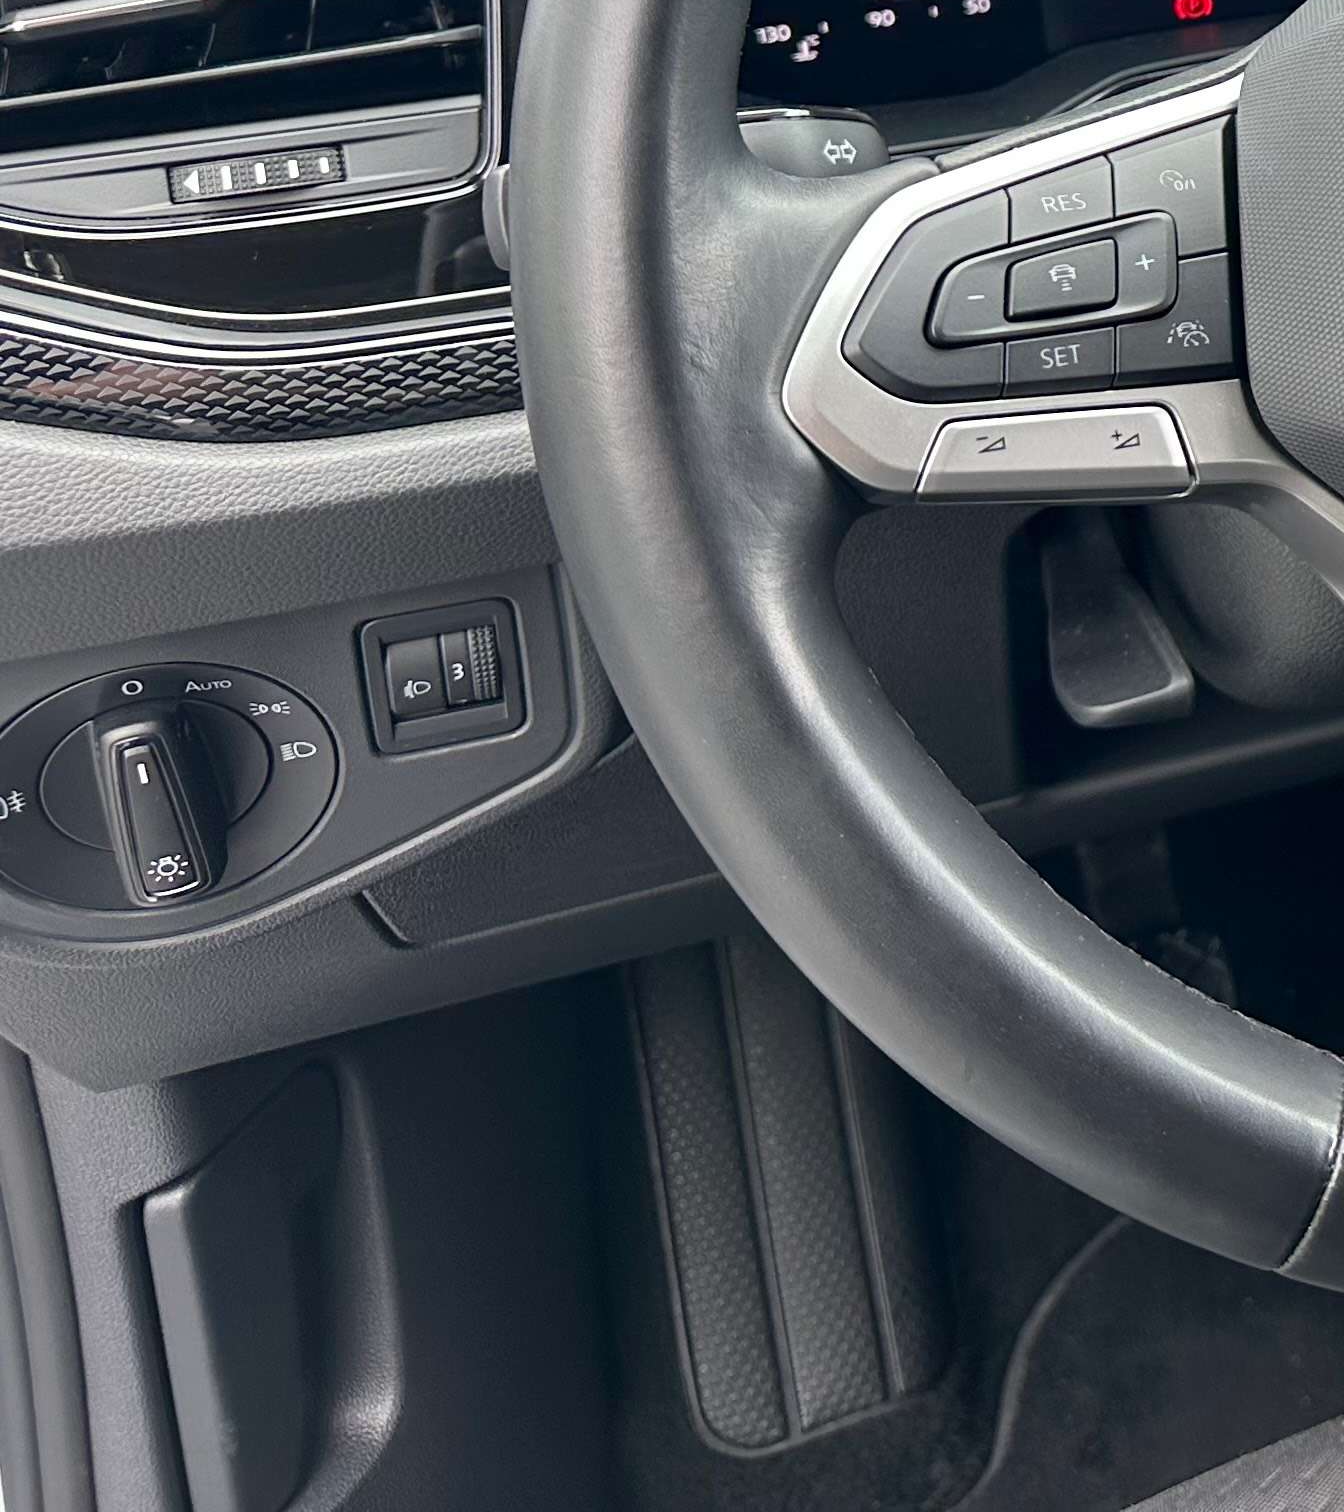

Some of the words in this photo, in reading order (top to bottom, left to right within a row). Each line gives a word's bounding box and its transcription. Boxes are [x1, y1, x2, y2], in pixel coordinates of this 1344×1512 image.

[864, 8, 896, 28] 90
[752, 23, 792, 45] 130
[1041, 192, 1087, 214] RES
[1039, 344, 1081, 369] SET
[451, 662, 465, 681] 3
